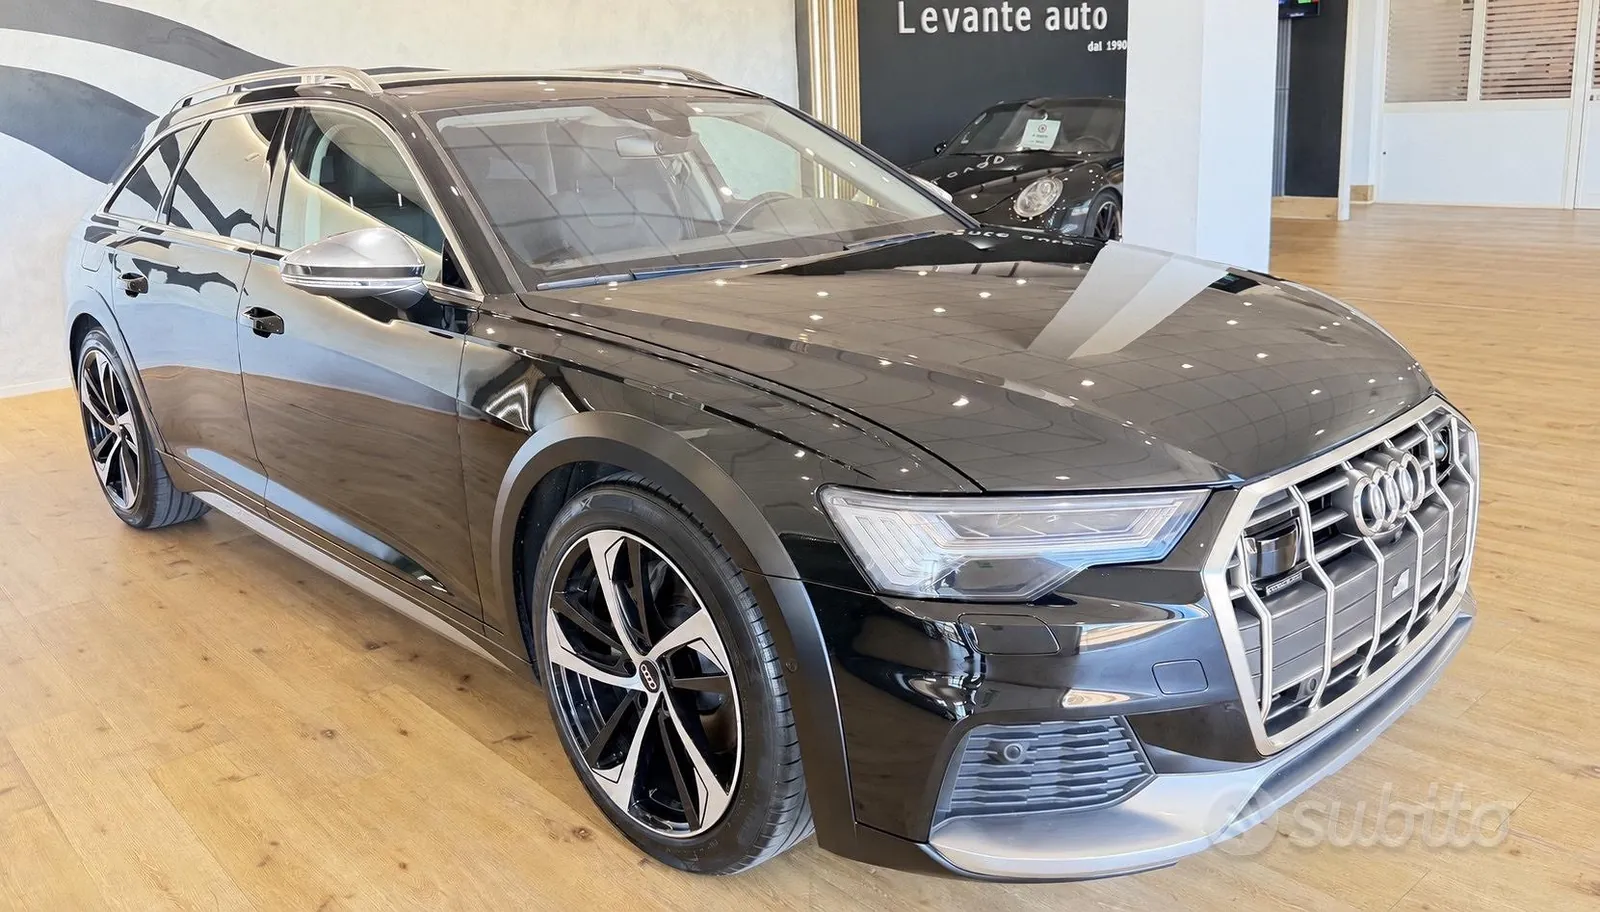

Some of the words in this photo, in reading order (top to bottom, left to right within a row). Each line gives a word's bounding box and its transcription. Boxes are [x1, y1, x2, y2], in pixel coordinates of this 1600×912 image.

[897, 0, 1031, 34] Levante
[1044, 2, 1108, 31] auto
[1087, 40, 1103, 52] dal
[1106, 39, 1127, 51] 1990
